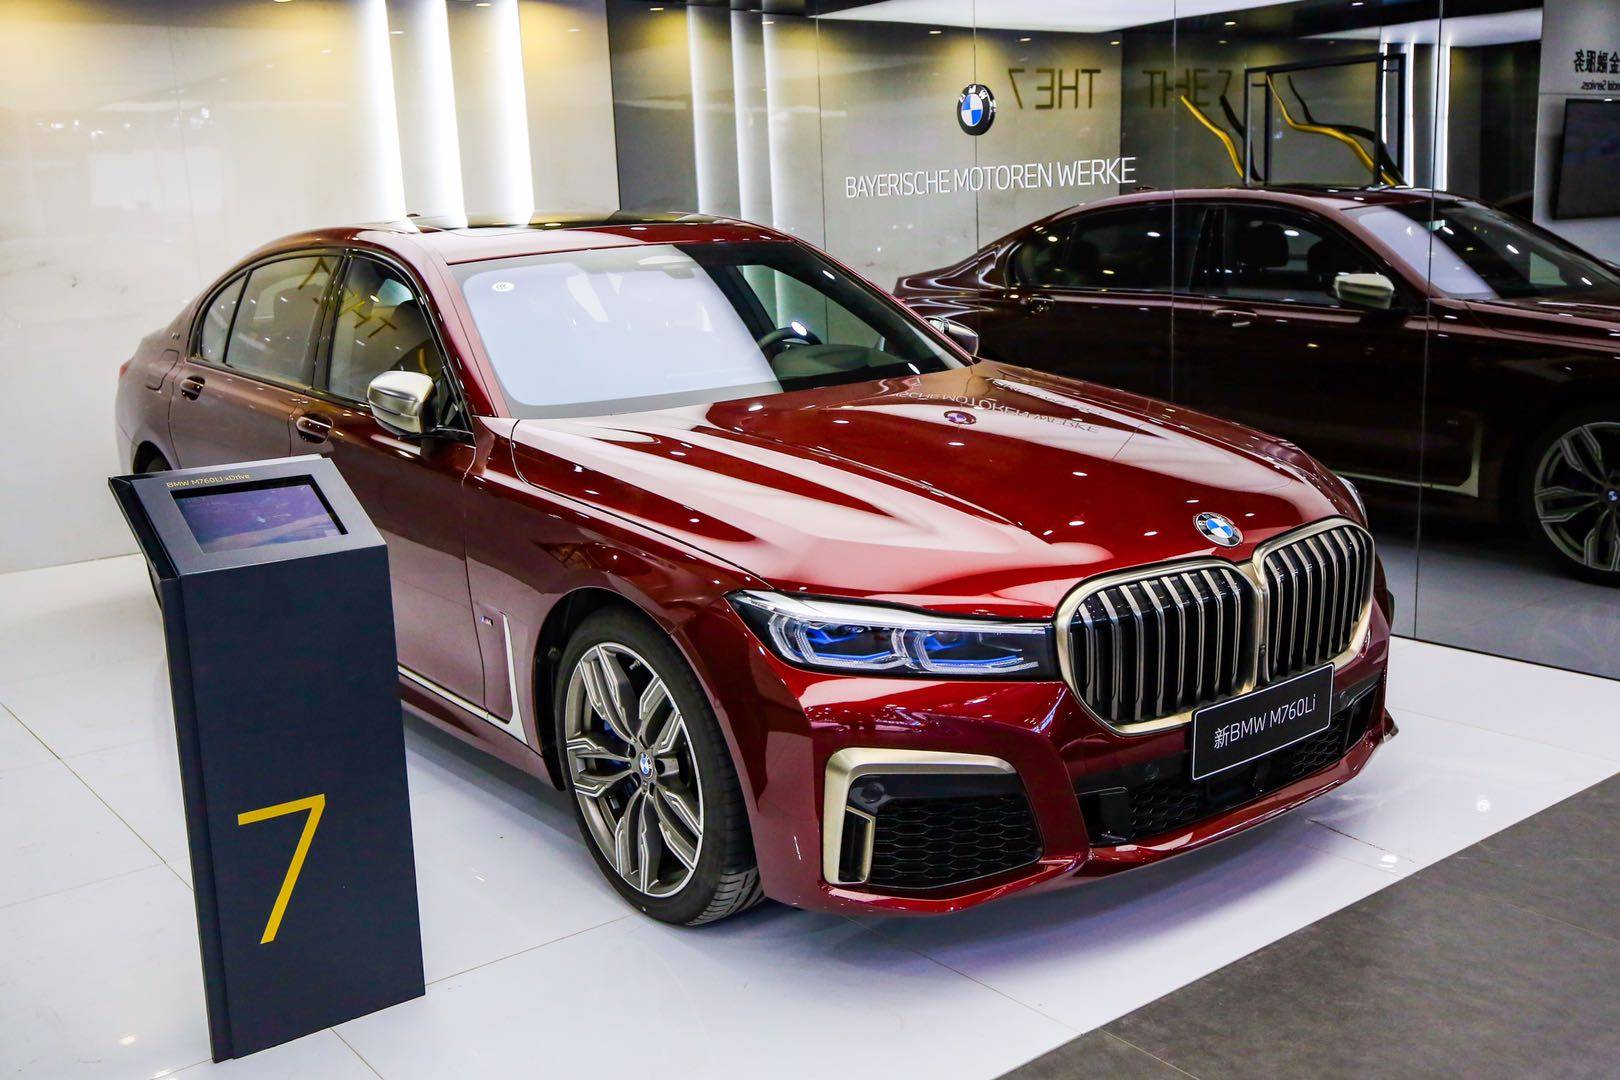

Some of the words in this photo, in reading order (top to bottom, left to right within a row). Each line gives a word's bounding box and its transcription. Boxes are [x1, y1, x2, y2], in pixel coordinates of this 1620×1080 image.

[845, 169, 950, 199] BAYERISCHE
[953, 162, 1052, 192] MOTOREN
[1056, 156, 1137, 187] WERKE
[1269, 693, 1317, 728] M760Li
[237, 793, 326, 945] 7
